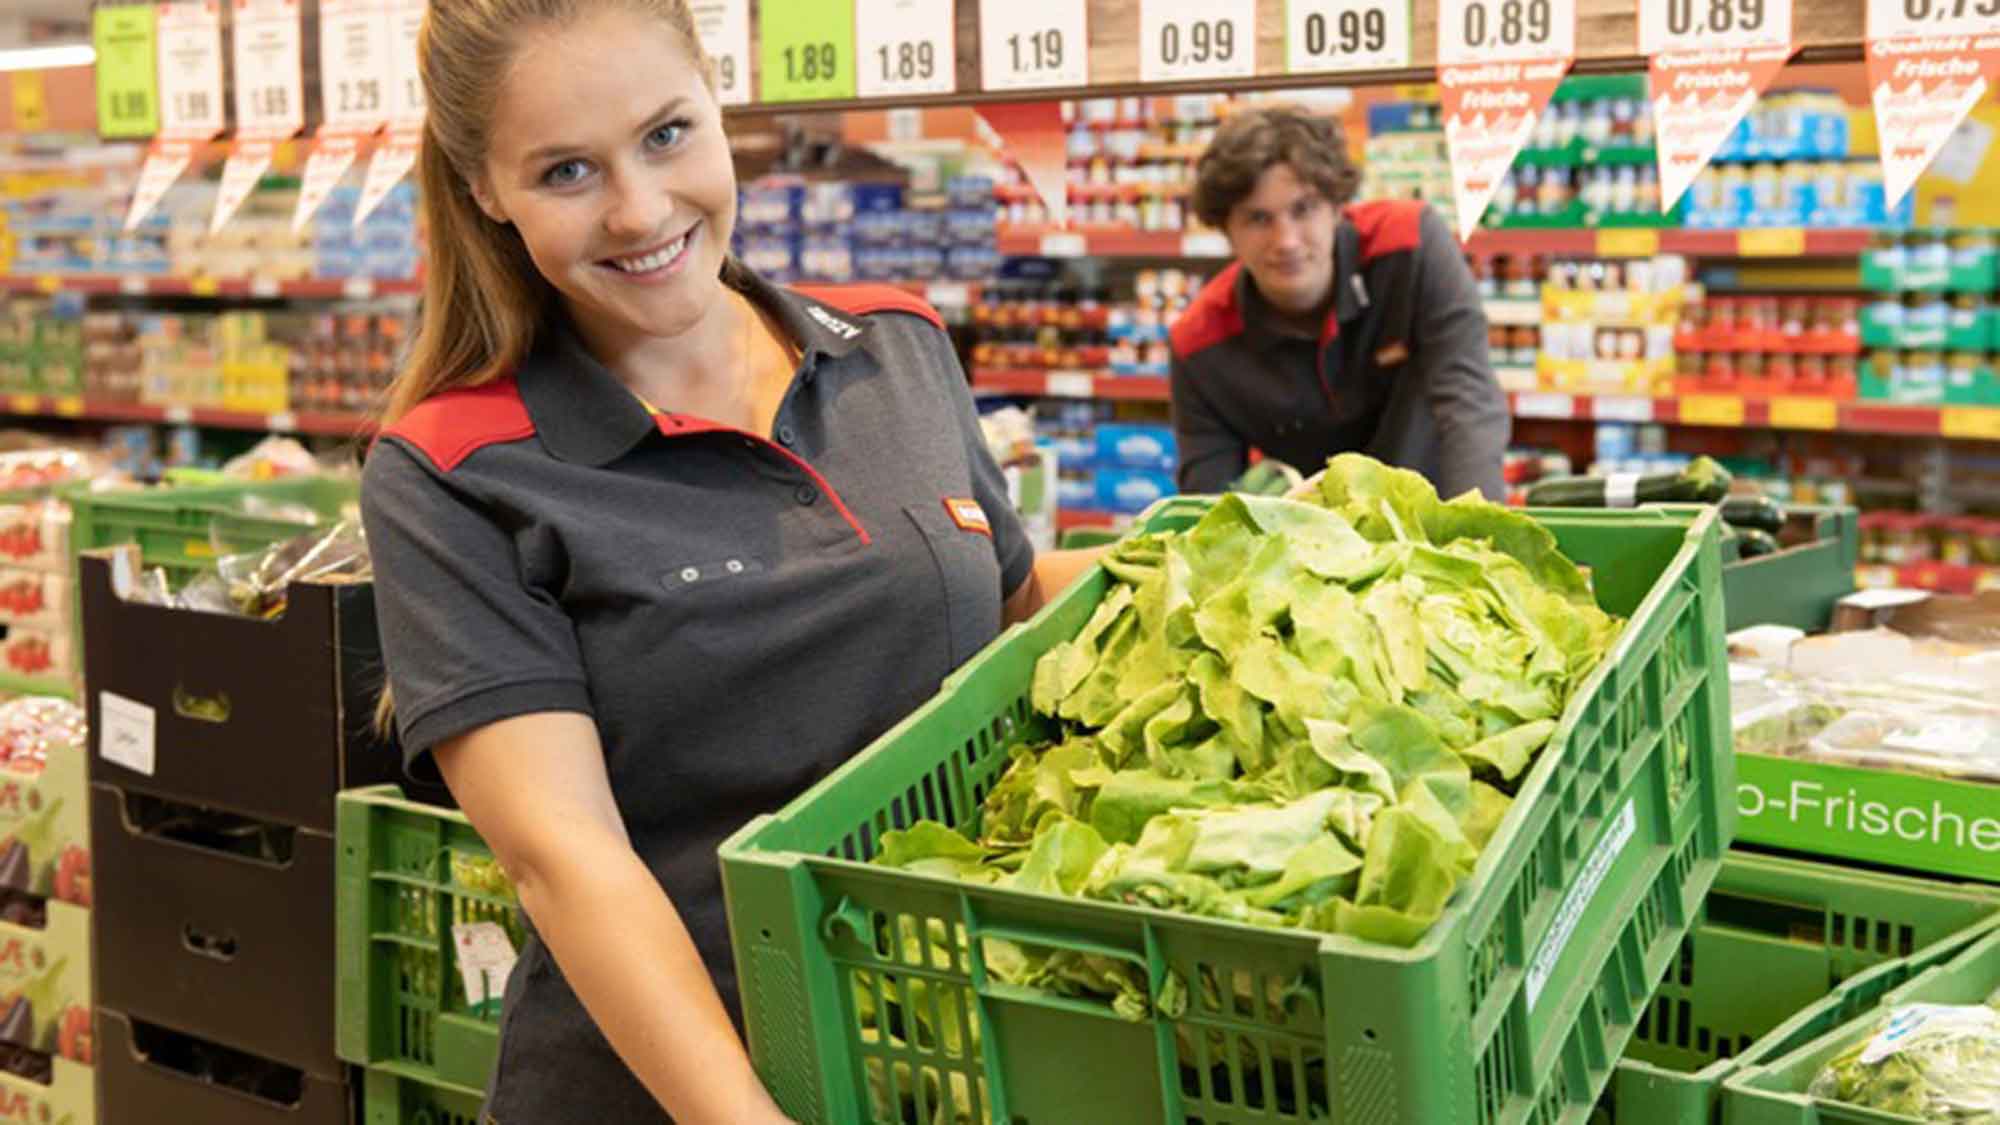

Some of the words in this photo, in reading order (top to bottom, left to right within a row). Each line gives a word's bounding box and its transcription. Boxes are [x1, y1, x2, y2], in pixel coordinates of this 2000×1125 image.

[1305, 8, 1386, 56] 0,99
[1464, 0, 1551, 49] 0,89
[1161, 19, 1234, 66] 0,99
[1674, 69, 1750, 90] Frische
[1893, 58, 1980, 78] Frische
[1461, 88, 1531, 110] Frische
